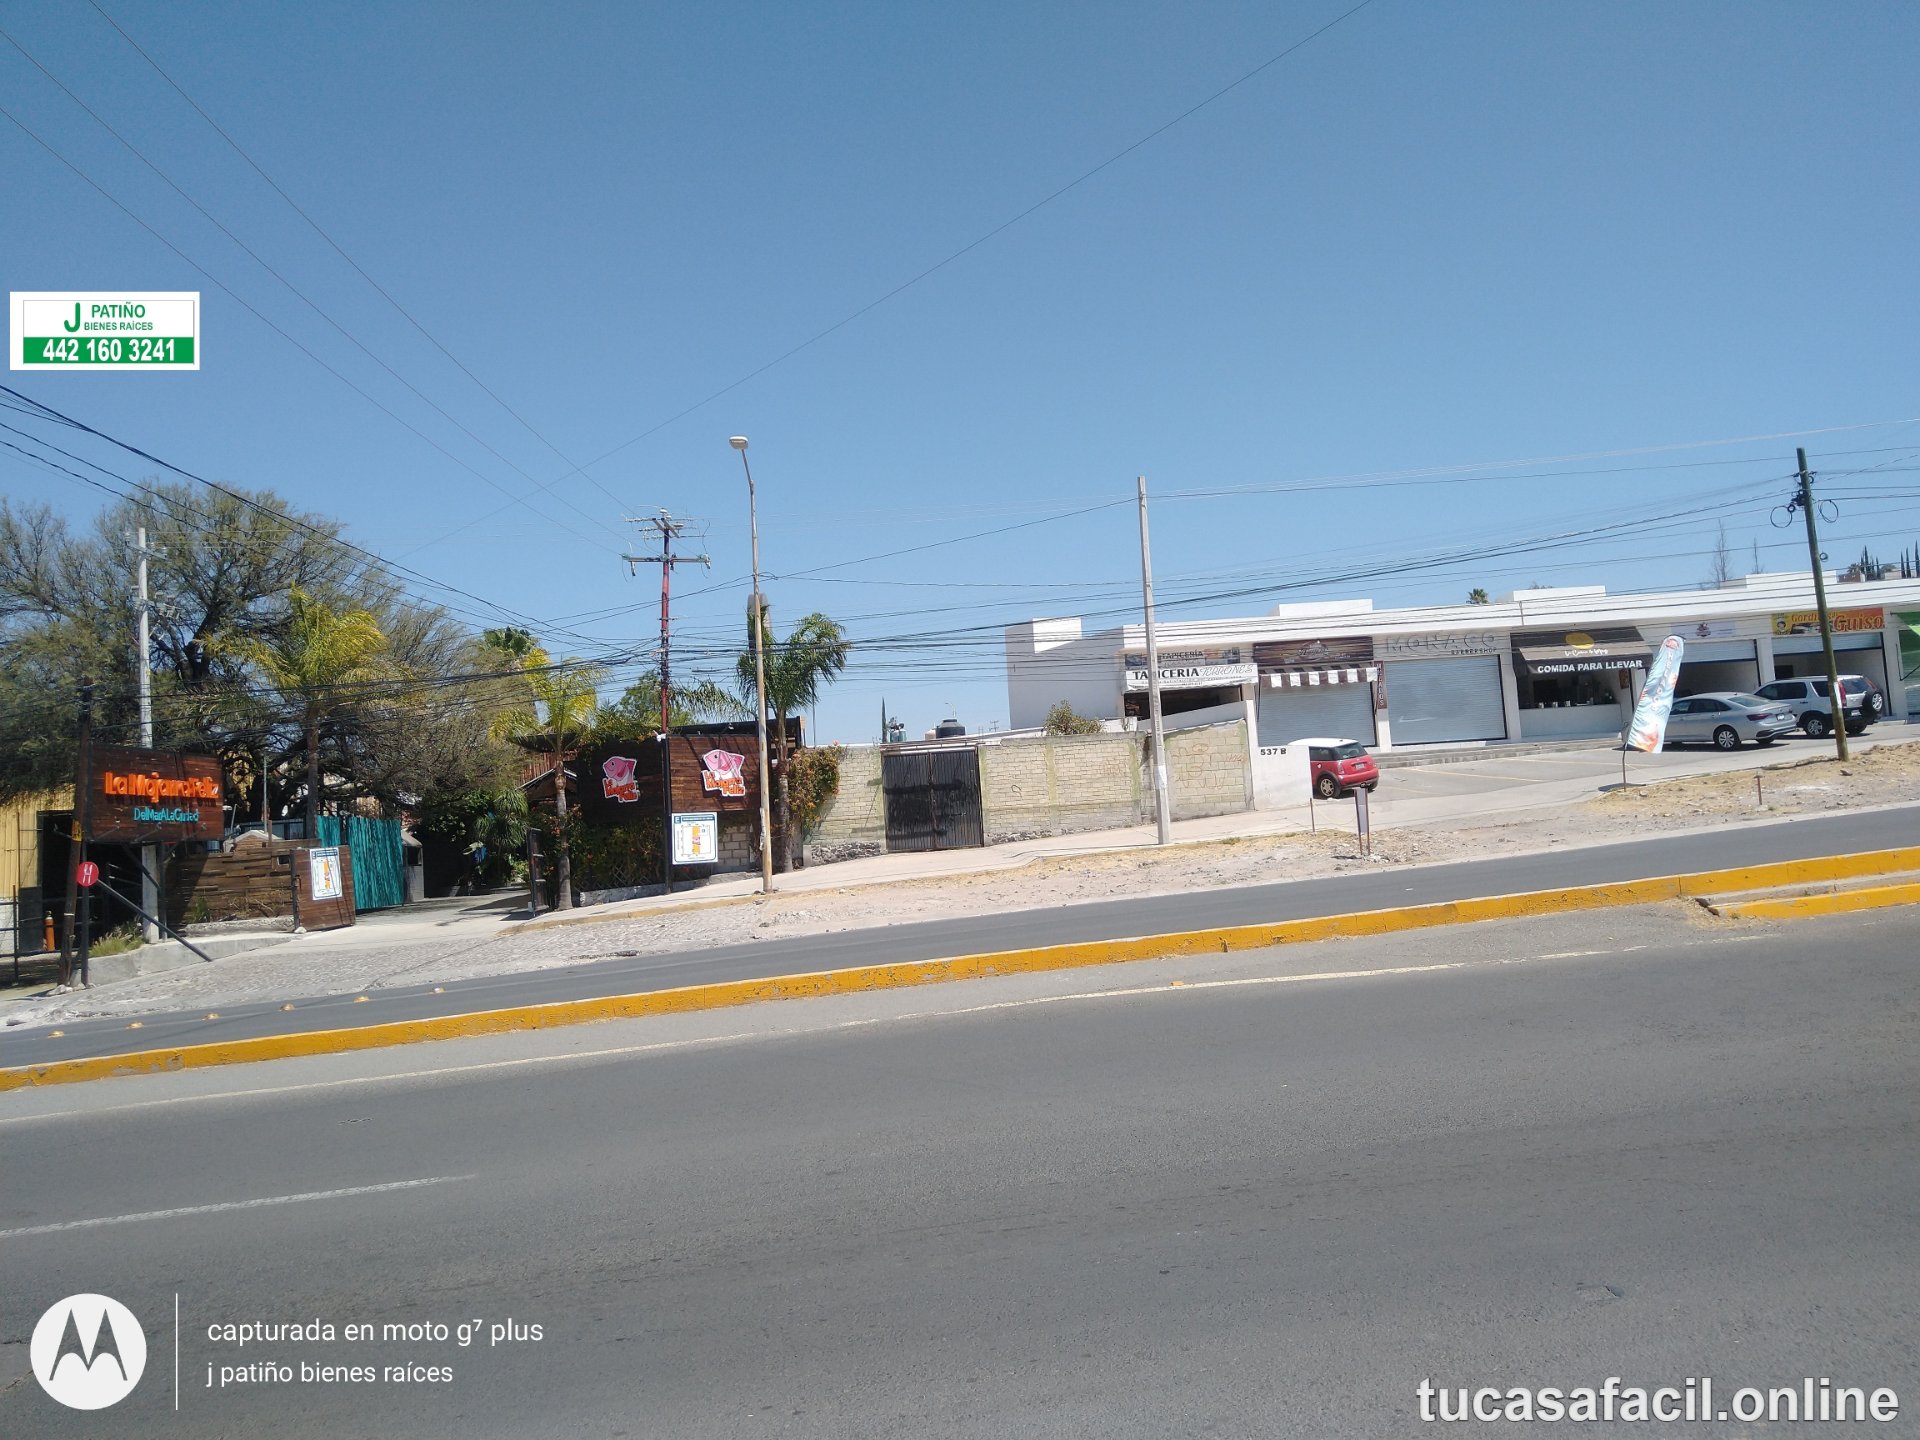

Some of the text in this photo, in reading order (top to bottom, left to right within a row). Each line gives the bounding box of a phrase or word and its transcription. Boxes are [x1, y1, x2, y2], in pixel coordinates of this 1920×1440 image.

[1537, 660, 1643, 673] COMIDA PARA LLEVAR
[1132, 668, 1199, 680] TAICERIA
